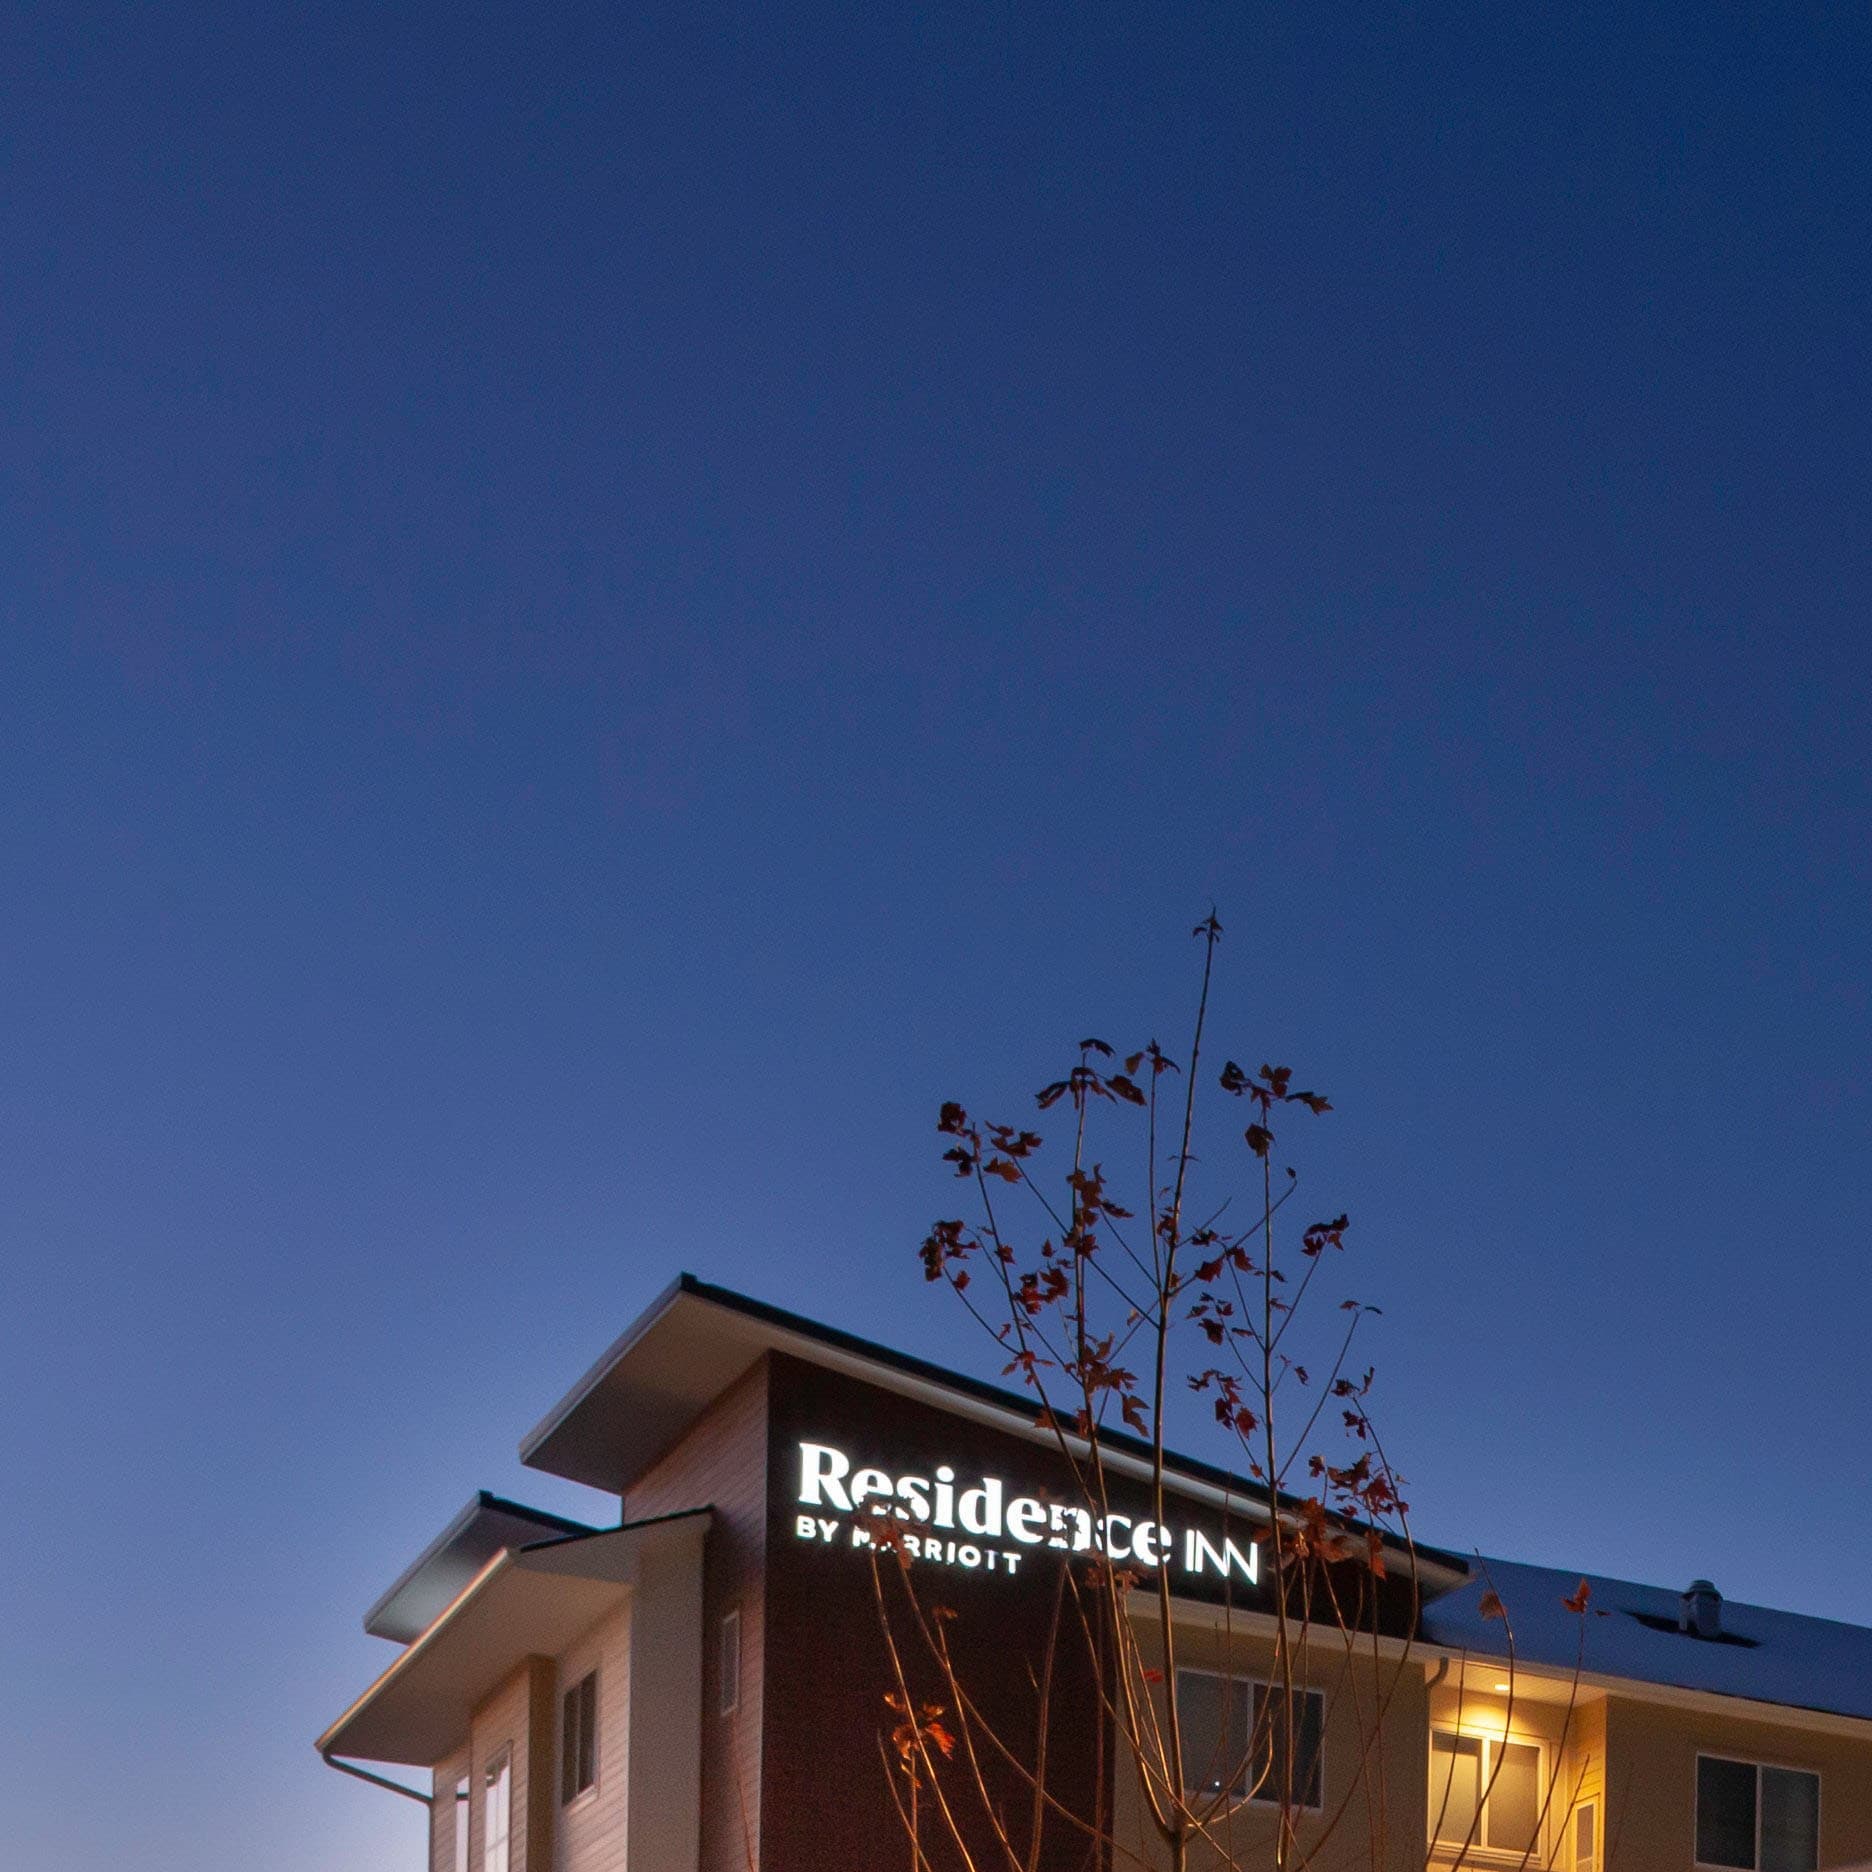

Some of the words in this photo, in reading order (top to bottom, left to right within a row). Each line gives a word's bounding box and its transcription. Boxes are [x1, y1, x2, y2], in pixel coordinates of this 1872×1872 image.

[796, 1515, 839, 1543] BY
[852, 1525, 1022, 1575] MRRIOTT
[799, 1442, 1173, 1567] Residence
[1185, 1528, 1258, 1585] INN
